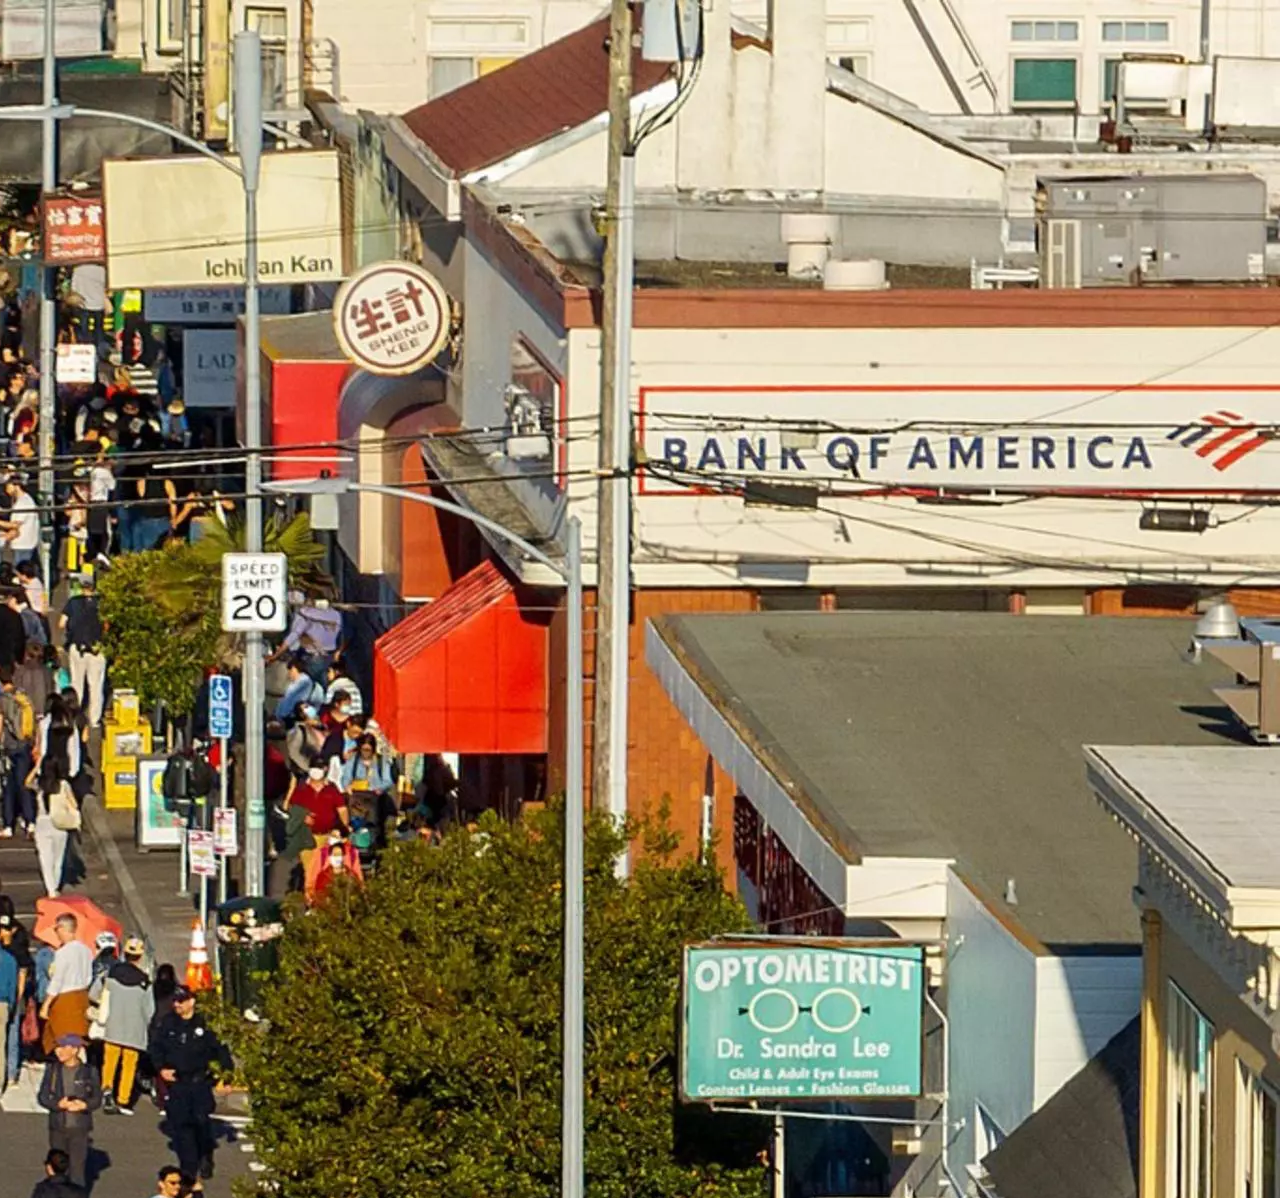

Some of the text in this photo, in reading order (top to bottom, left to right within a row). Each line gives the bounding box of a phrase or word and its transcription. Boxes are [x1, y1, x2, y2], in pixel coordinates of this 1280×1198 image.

[205, 254, 333, 277] Ichian Kan
[368, 320, 430, 351] SHENG
[385, 337, 421, 358] KEE
[663, 436, 1153, 470] BANK OF AMERICA
[230, 562, 280, 576] SPEED
[234, 578, 273, 590] LIMIT
[232, 594, 277, 621] 20
[695, 953, 915, 992] OPTOMETRIST
[717, 1036, 890, 1058] Dr. Sandra Lee
[729, 1068, 760, 1080] Child
[778, 1067, 811, 1080] Adult
[814, 1068, 835, 1083] Eye
[839, 1068, 880, 1080] Exams
[697, 1083, 912, 1096] Contact Lenses Fashion Glasses
